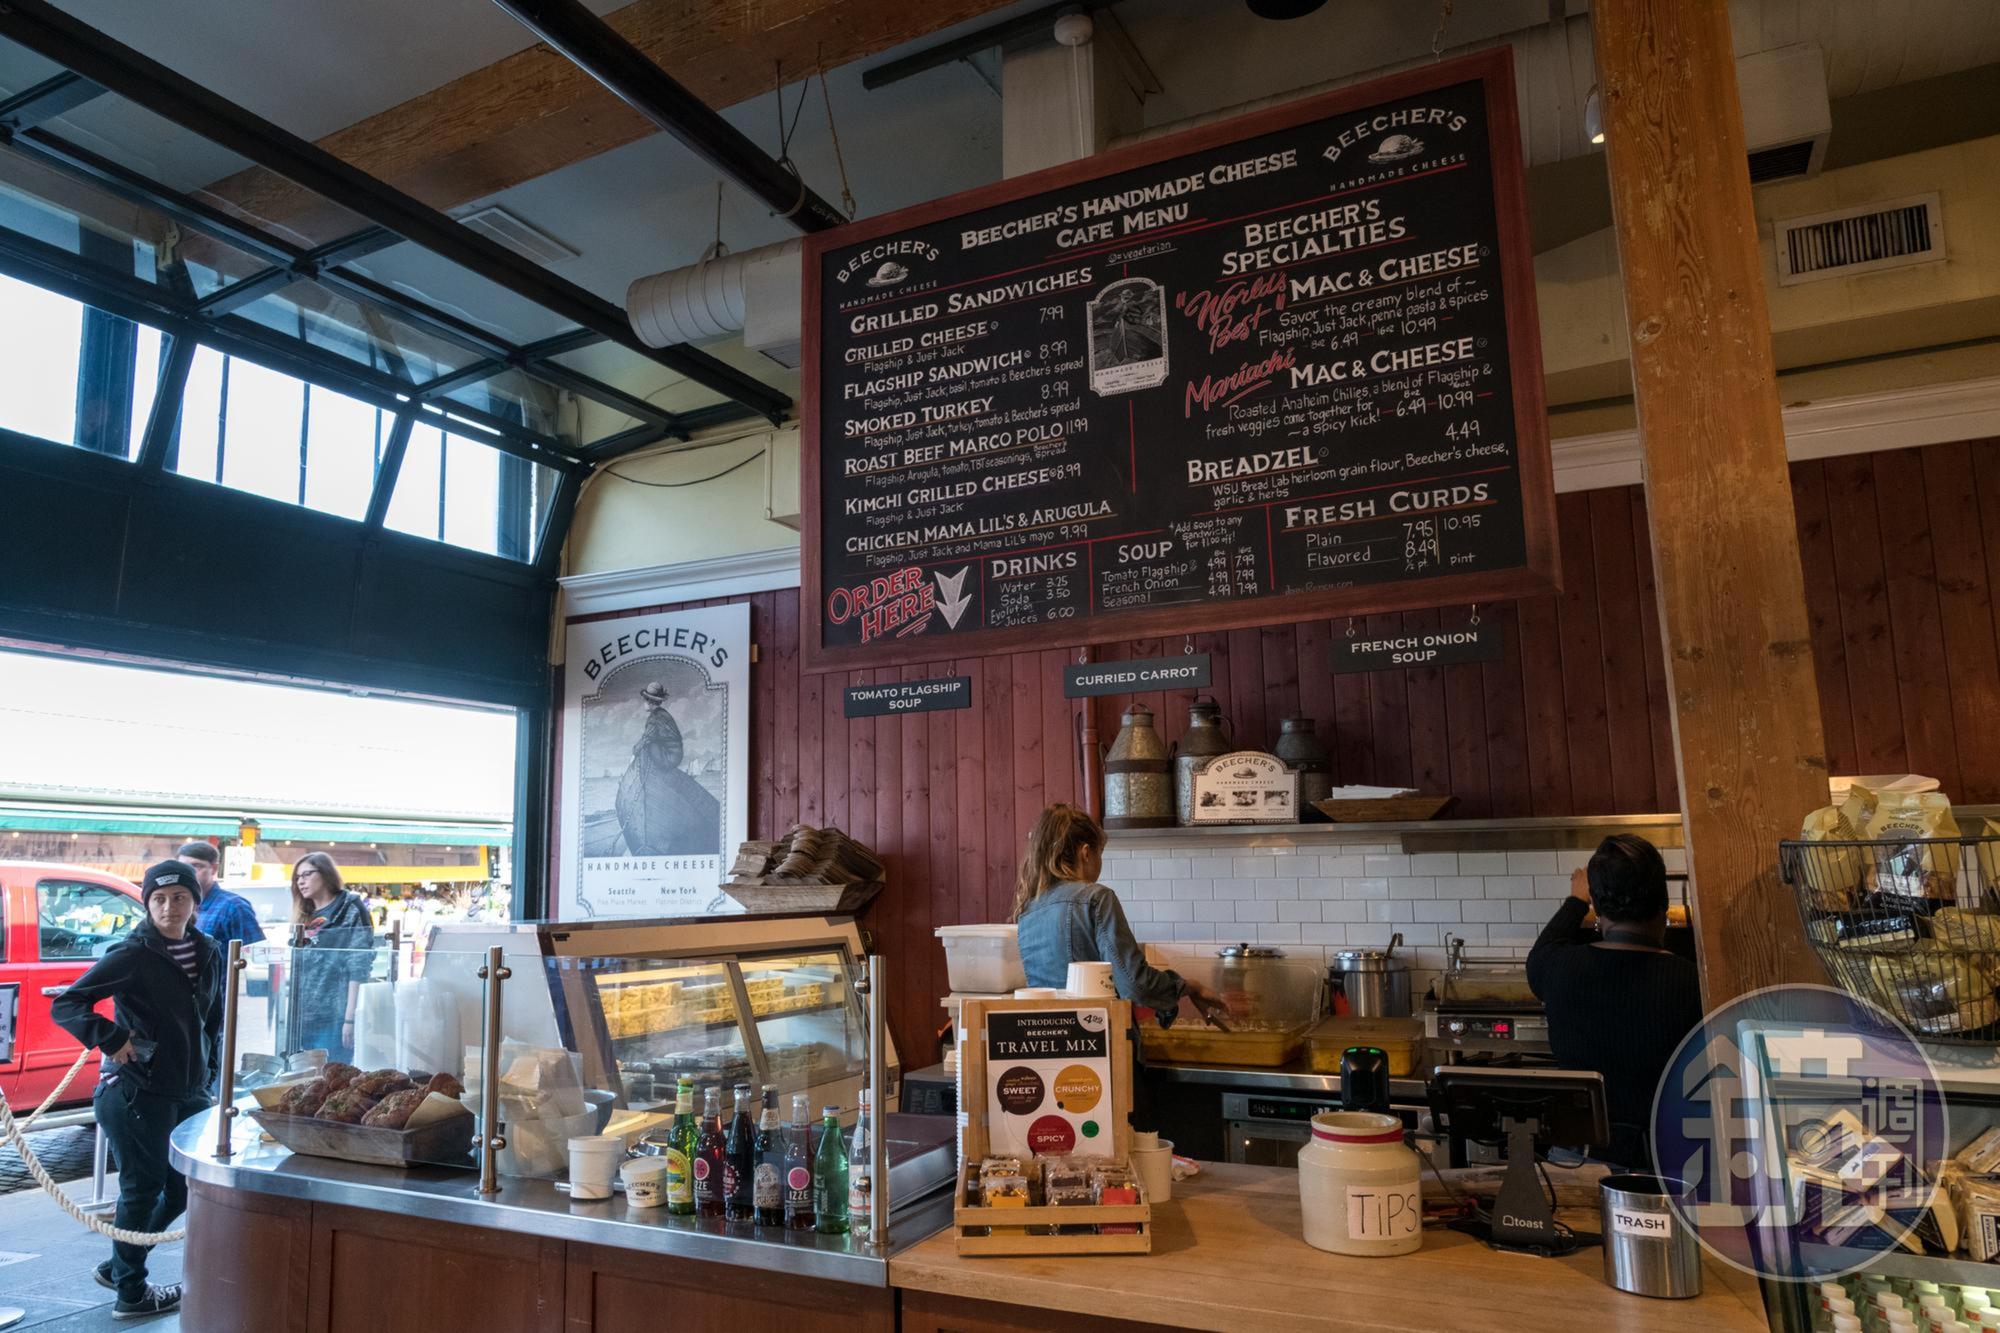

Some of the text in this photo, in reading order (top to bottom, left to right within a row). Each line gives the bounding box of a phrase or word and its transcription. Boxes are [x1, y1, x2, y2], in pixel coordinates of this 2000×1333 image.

[1321, 107, 1468, 163] BEECHER'S
[1330, 153, 1466, 192] HANDMADE CHEESE
[960, 149, 1297, 250] BEECHER'S HANDMADE CHEESE
[1055, 202, 1190, 249] CAFE MENU
[1244, 199, 1380, 247] BEECHER'S
[1221, 215, 1406, 275] SPECIALTIES
[836, 240, 939, 283] BEECHER'S
[1289, 242, 1480, 301] MAC & CHEESE
[839, 280, 938, 310] HANDMADE CHEESE
[850, 267, 1093, 334] GRILLED SANDWICHES
[1279, 276, 1461, 327] Savor the creamy blend of
[1371, 289, 1489, 330] penne pasta spices
[844, 337, 914, 363] GRILLED
[920, 321, 988, 347] CHEESE
[1330, 317, 1437, 350] 6.49 10.99
[843, 340, 1067, 399] FLAGSHIP SANDWICH 8.99
[864, 345, 965, 374] Flagship Just Jack
[1009, 361, 1051, 382] Beecher's
[1054, 356, 1084, 375] spread
[1185, 346, 1296, 419] Mariachi
[1290, 361, 1348, 389] MAC
[1351, 359, 1368, 379] &
[1370, 336, 1475, 374] CHEESE
[1229, 365, 1479, 421] Roasted Anaheim Flagship
[1396, 390, 1474, 417] 6.49 10.99
[844, 380, 1069, 436] SMOKED TURKEY 8.99
[1011, 396, 1081, 422] Beecher's spread
[1205, 398, 1373, 440] fresh veggies together for
[1445, 420, 1481, 441] 4.49
[844, 452, 898, 475] ROAST
[904, 443, 945, 465] BEEF
[949, 432, 1012, 457] MARCO
[1016, 422, 1063, 445] POLO
[1186, 445, 1319, 483] BREADZEL
[1212, 442, 1509, 496] WSU Bread Lab heirloom grain flour, Beecher's cheese,
[845, 462, 1081, 515] KIMCHI GRILLED CHEESE 8.99
[1213, 488, 1290, 511] garlic herbs
[866, 502, 965, 528] Flagship Just Jack
[1284, 482, 1489, 529] FRESH CURDS
[845, 500, 1112, 552] CHICKEN, MAMA LIL'S & ARUGULA
[932, 523, 1088, 557] Jack Mama mayo 9.99
[1182, 527, 1228, 542] sandwich
[1306, 514, 1482, 548] Plain 7.95 10.95
[991, 551, 1078, 579] DRINKS
[1118, 541, 1173, 563] SOUP
[1307, 538, 1437, 568] Flavored 8.49
[1449, 552, 1477, 568] pint
[1101, 554, 1255, 582] Tomato Flagship 7.99
[1102, 569, 1255, 595] French Onion 4.99 7.99
[827, 566, 925, 625] ORDER
[1000, 575, 1069, 594] Water 3.25
[1000, 588, 1071, 606] Soda 3.50
[1103, 582, 1258, 608] Seasonal 4.99 7.99
[861, 581, 936, 644] HERE
[1003, 606, 1075, 628] Juices 6.00
[584, 628, 729, 681] BEECHER'S
[1351, 631, 1478, 654] FRENCH ONION
[1391, 649, 1437, 664] SOUP
[1075, 666, 1198, 686] CURRIED CARROT
[850, 682, 961, 701] TOMATO FLAGSHIP
[888, 697, 922, 711] SOUP
[1215, 757, 1276, 773] BEECHER'S
[587, 859, 715, 872] HANDMADE CHEESE
[608, 887, 636, 895] Seattle
[660, 886, 697, 894] New York
[1017, 1018, 1076, 1027] INTRODUCING
[1026, 1029, 1069, 1037] BEECHER'S
[997, 1039, 1098, 1054] TRAVEL MIX
[1003, 1086, 1037, 1095] SWEET
[1055, 1085, 1100, 1093] CRUNCHY
[1036, 1135, 1065, 1143] SPICY
[789, 1190, 809, 1200] IZZE
[1514, 1217, 1544, 1230] toast
[1614, 1214, 1666, 1231] TRASH
